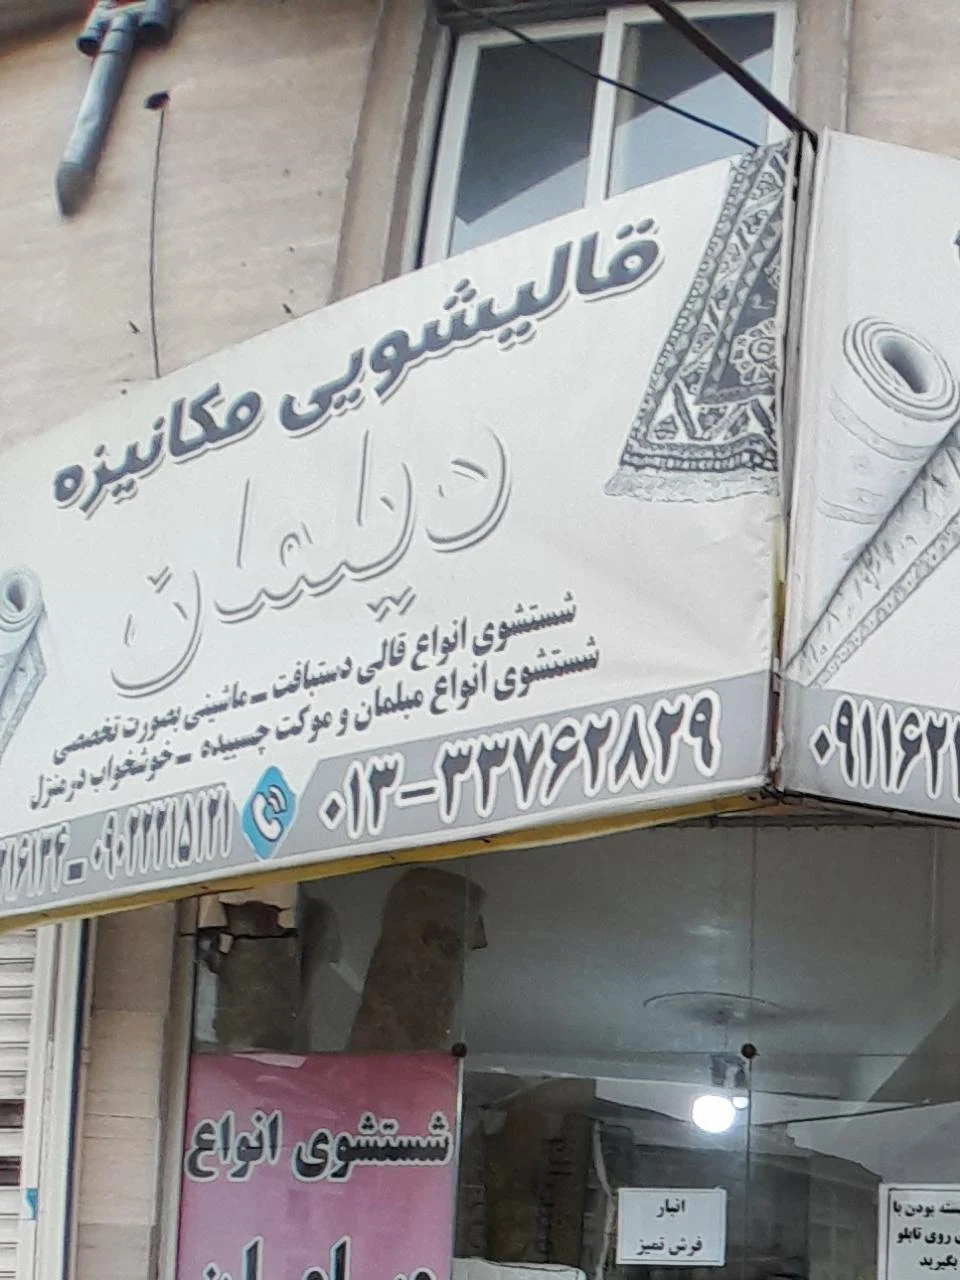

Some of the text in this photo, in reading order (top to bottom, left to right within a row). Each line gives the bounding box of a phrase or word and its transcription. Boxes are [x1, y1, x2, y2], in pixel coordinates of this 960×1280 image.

[52, 218, 666, 515] قالیشویی مکانیزه
[411, 615, 467, 671] انواع
[473, 590, 577, 655] شستشوی
[272, 656, 351, 698] دستبافت
[356, 632, 407, 685] قالی
[494, 635, 600, 701] شستشوی
[184, 682, 249, 730] ماشینی
[354, 680, 424, 731] مبلمان
[429, 660, 488, 715] انواع
[53, 715, 119, 765] تخصصی
[122, 707, 182, 747] بصورت
[200, 725, 270, 761] چسبیده
[275, 705, 331, 743] موکت
[335, 707, 349, 735] و
[90, 741, 172, 790] خوشخواب
[186, 1110, 453, 1182] شستشوی انواع
[656, 1198, 686, 1218] انبار
[904, 1204, 935, 1217] بودن
[636, 1236, 703, 1256] فرش تمیز
[896, 1227, 923, 1243] تابلو
[924, 1231, 950, 1244] روی
[920, 1254, 958, 1271] بگیرید
